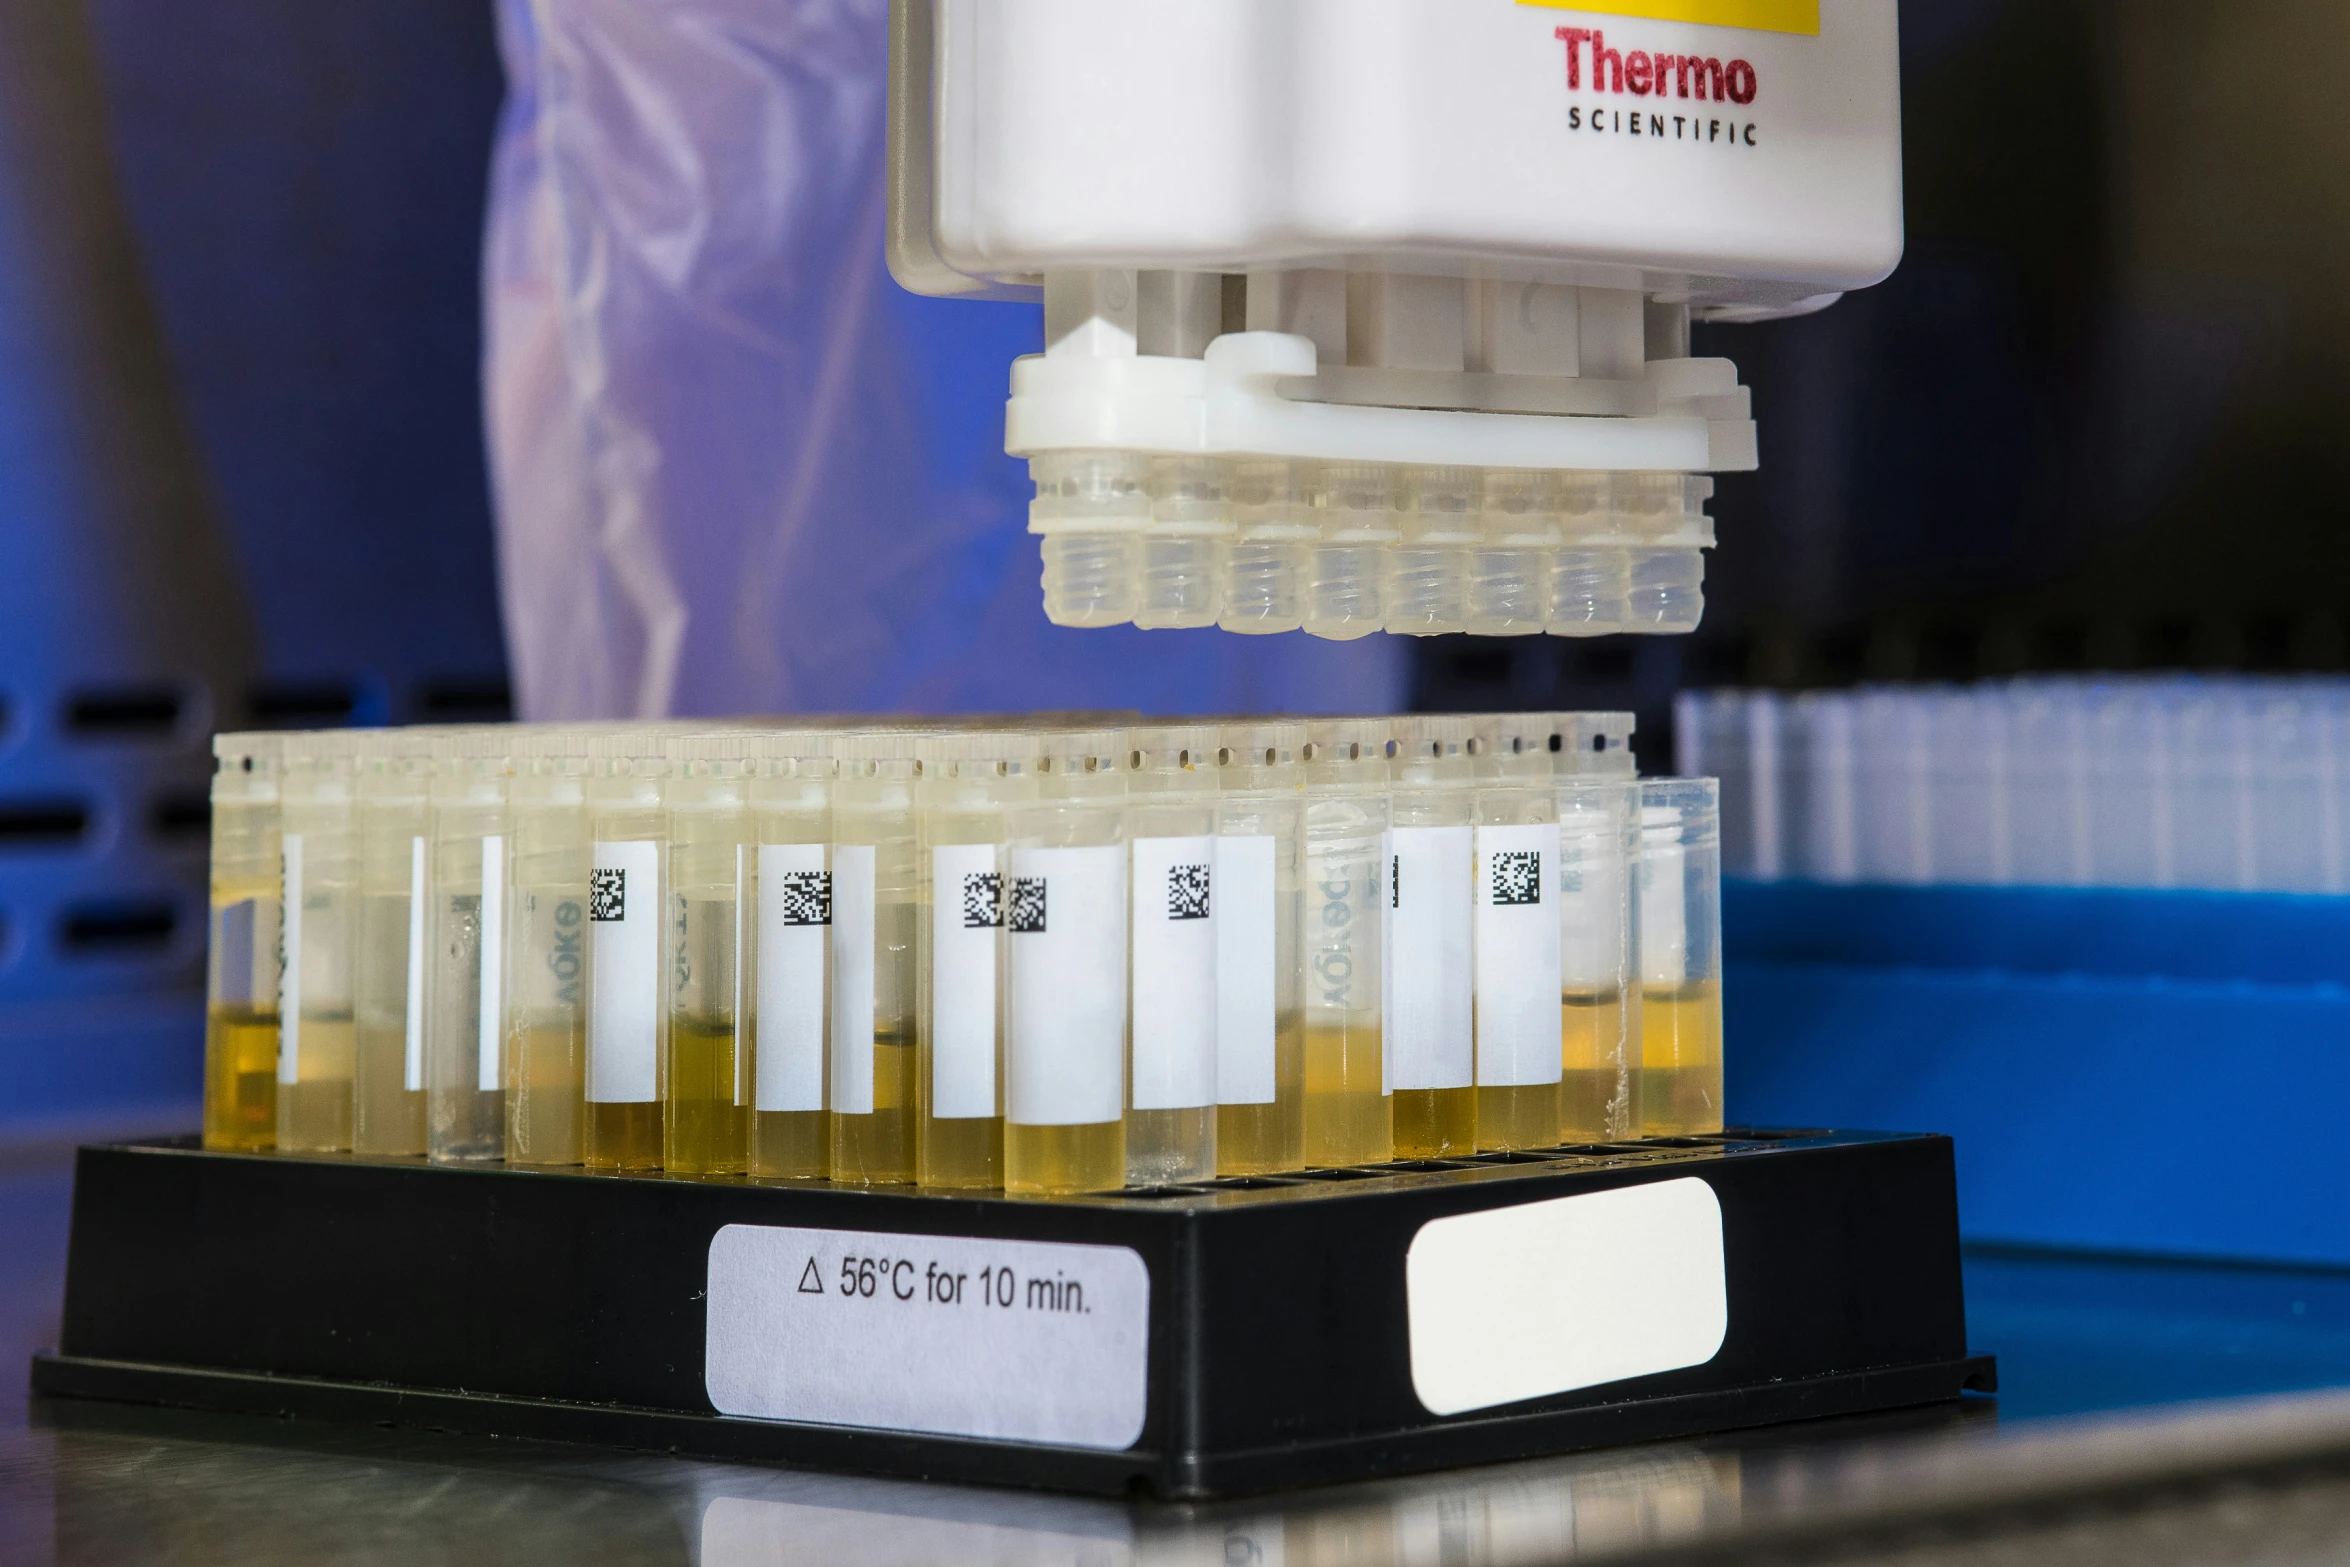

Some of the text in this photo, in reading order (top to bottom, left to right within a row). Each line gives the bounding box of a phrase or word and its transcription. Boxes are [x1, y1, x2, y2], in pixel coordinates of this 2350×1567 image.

[1554, 26, 1758, 105] Thermo
[1569, 106, 1758, 147] SCIENTIFIC
[839, 1256, 915, 1301] 56°C
[926, 1261, 968, 1305] for
[979, 1266, 1016, 1308] 10
[1027, 1270, 1092, 1315] min.
